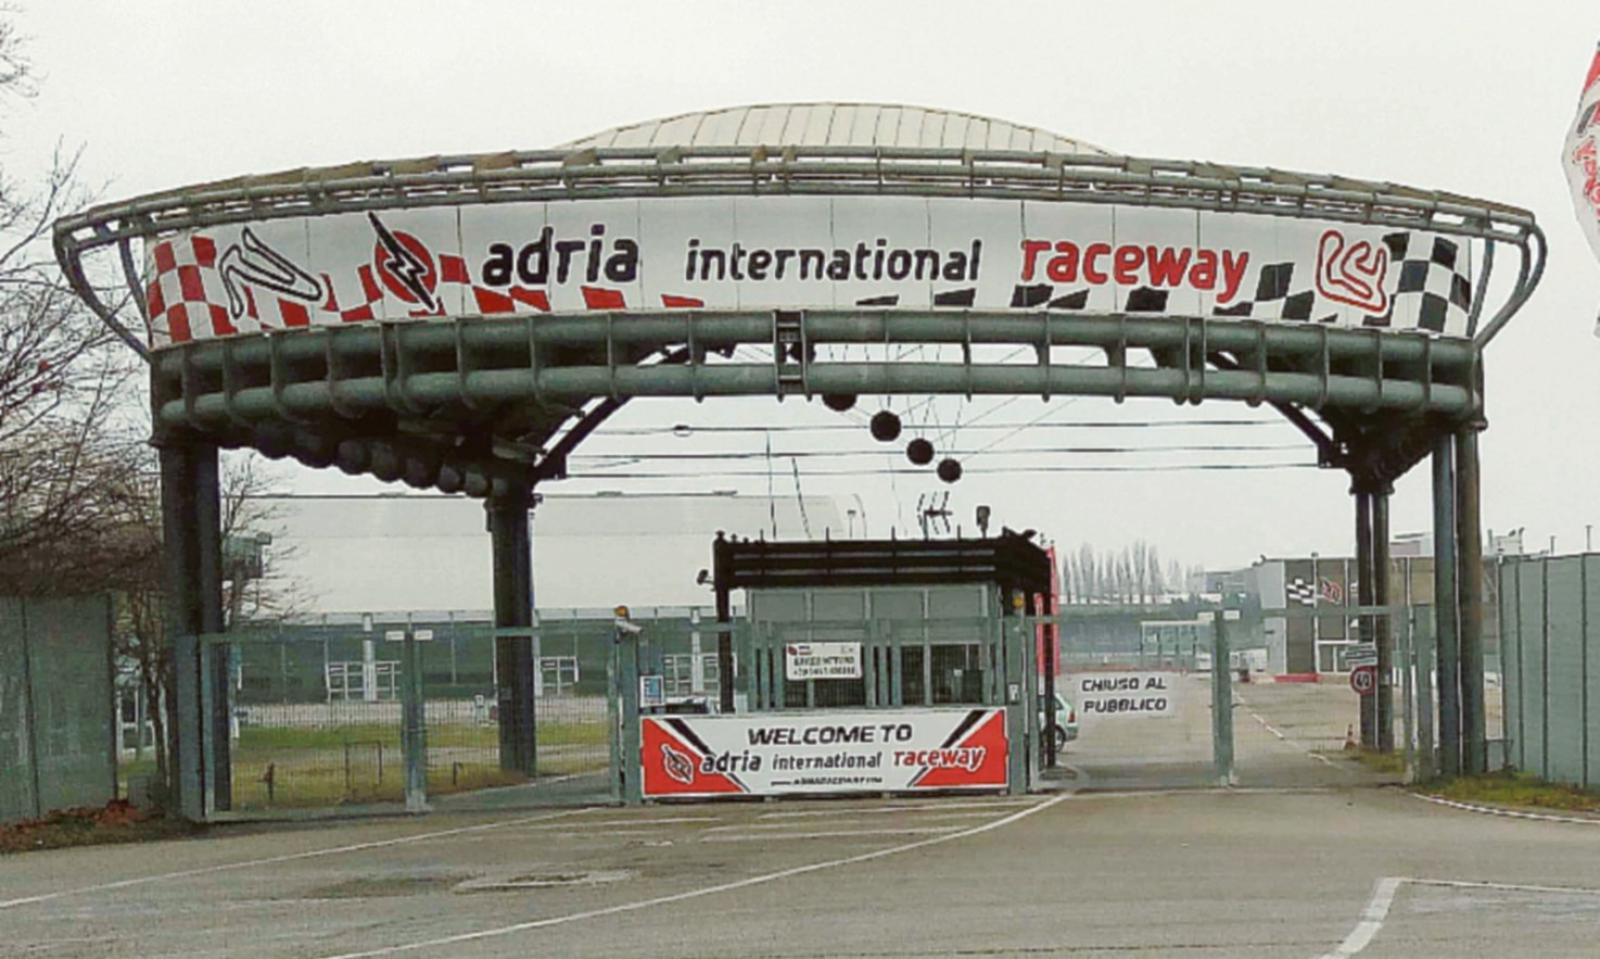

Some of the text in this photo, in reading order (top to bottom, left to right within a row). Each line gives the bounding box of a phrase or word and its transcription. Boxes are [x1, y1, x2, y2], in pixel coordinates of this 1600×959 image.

[481, 224, 1250, 303] adria international raceway
[1081, 677, 1167, 692] CHIUSO AL
[1083, 698, 1168, 713] PUBBLICO
[748, 724, 913, 746] WELCOME TO
[701, 746, 985, 772] adria international raceway
